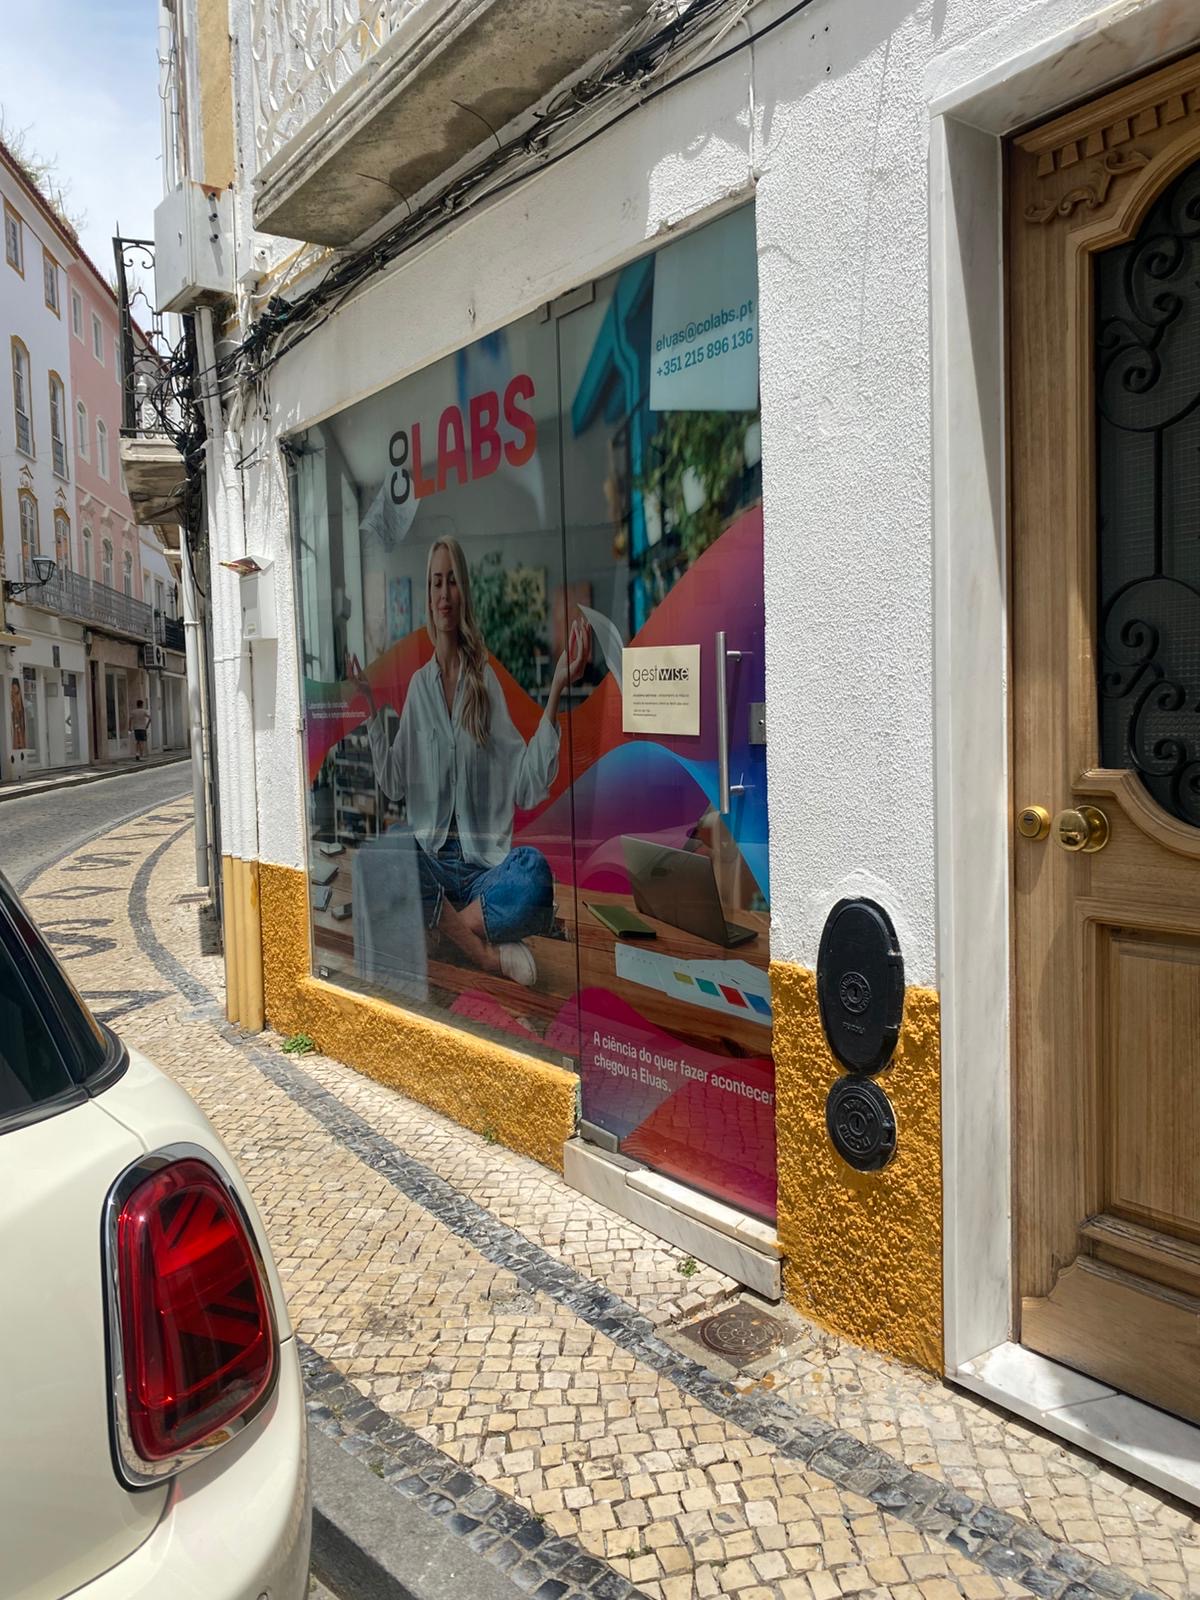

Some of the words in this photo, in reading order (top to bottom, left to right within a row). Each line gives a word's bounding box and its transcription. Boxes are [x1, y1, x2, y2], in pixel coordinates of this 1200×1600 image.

[656, 356, 682, 377] +351
[685, 346, 704, 368] 215
[706, 336, 729, 360] 896
[732, 327, 753, 350] 136
[411, 374, 537, 500] LABS
[593, 1031, 601, 1047] A
[602, 1035, 637, 1059] ciência
[639, 1047, 652, 1064] do
[654, 1054, 678, 1073] quer
[680, 1060, 708, 1083] fazer
[594, 1052, 630, 1077] chegou
[631, 1068, 638, 1080] a
